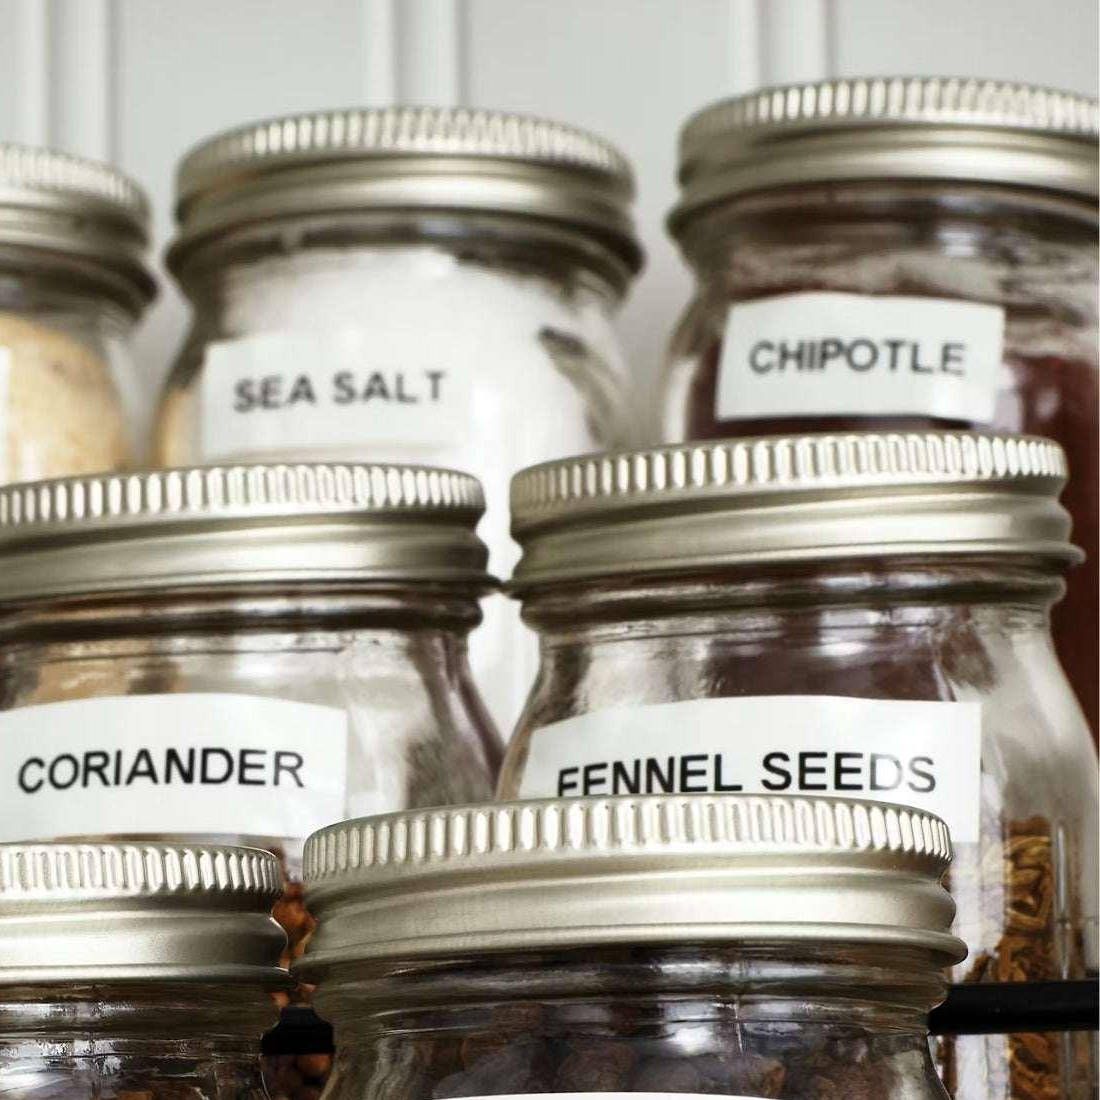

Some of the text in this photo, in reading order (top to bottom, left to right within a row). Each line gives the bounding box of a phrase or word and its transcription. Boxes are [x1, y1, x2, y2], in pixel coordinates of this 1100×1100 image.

[747, 336, 967, 377] CHIPOTLE
[232, 369, 446, 413] SEA SALT
[16, 746, 306, 796] CORIANDER
[556, 751, 937, 797] FENNEL SEEDS
